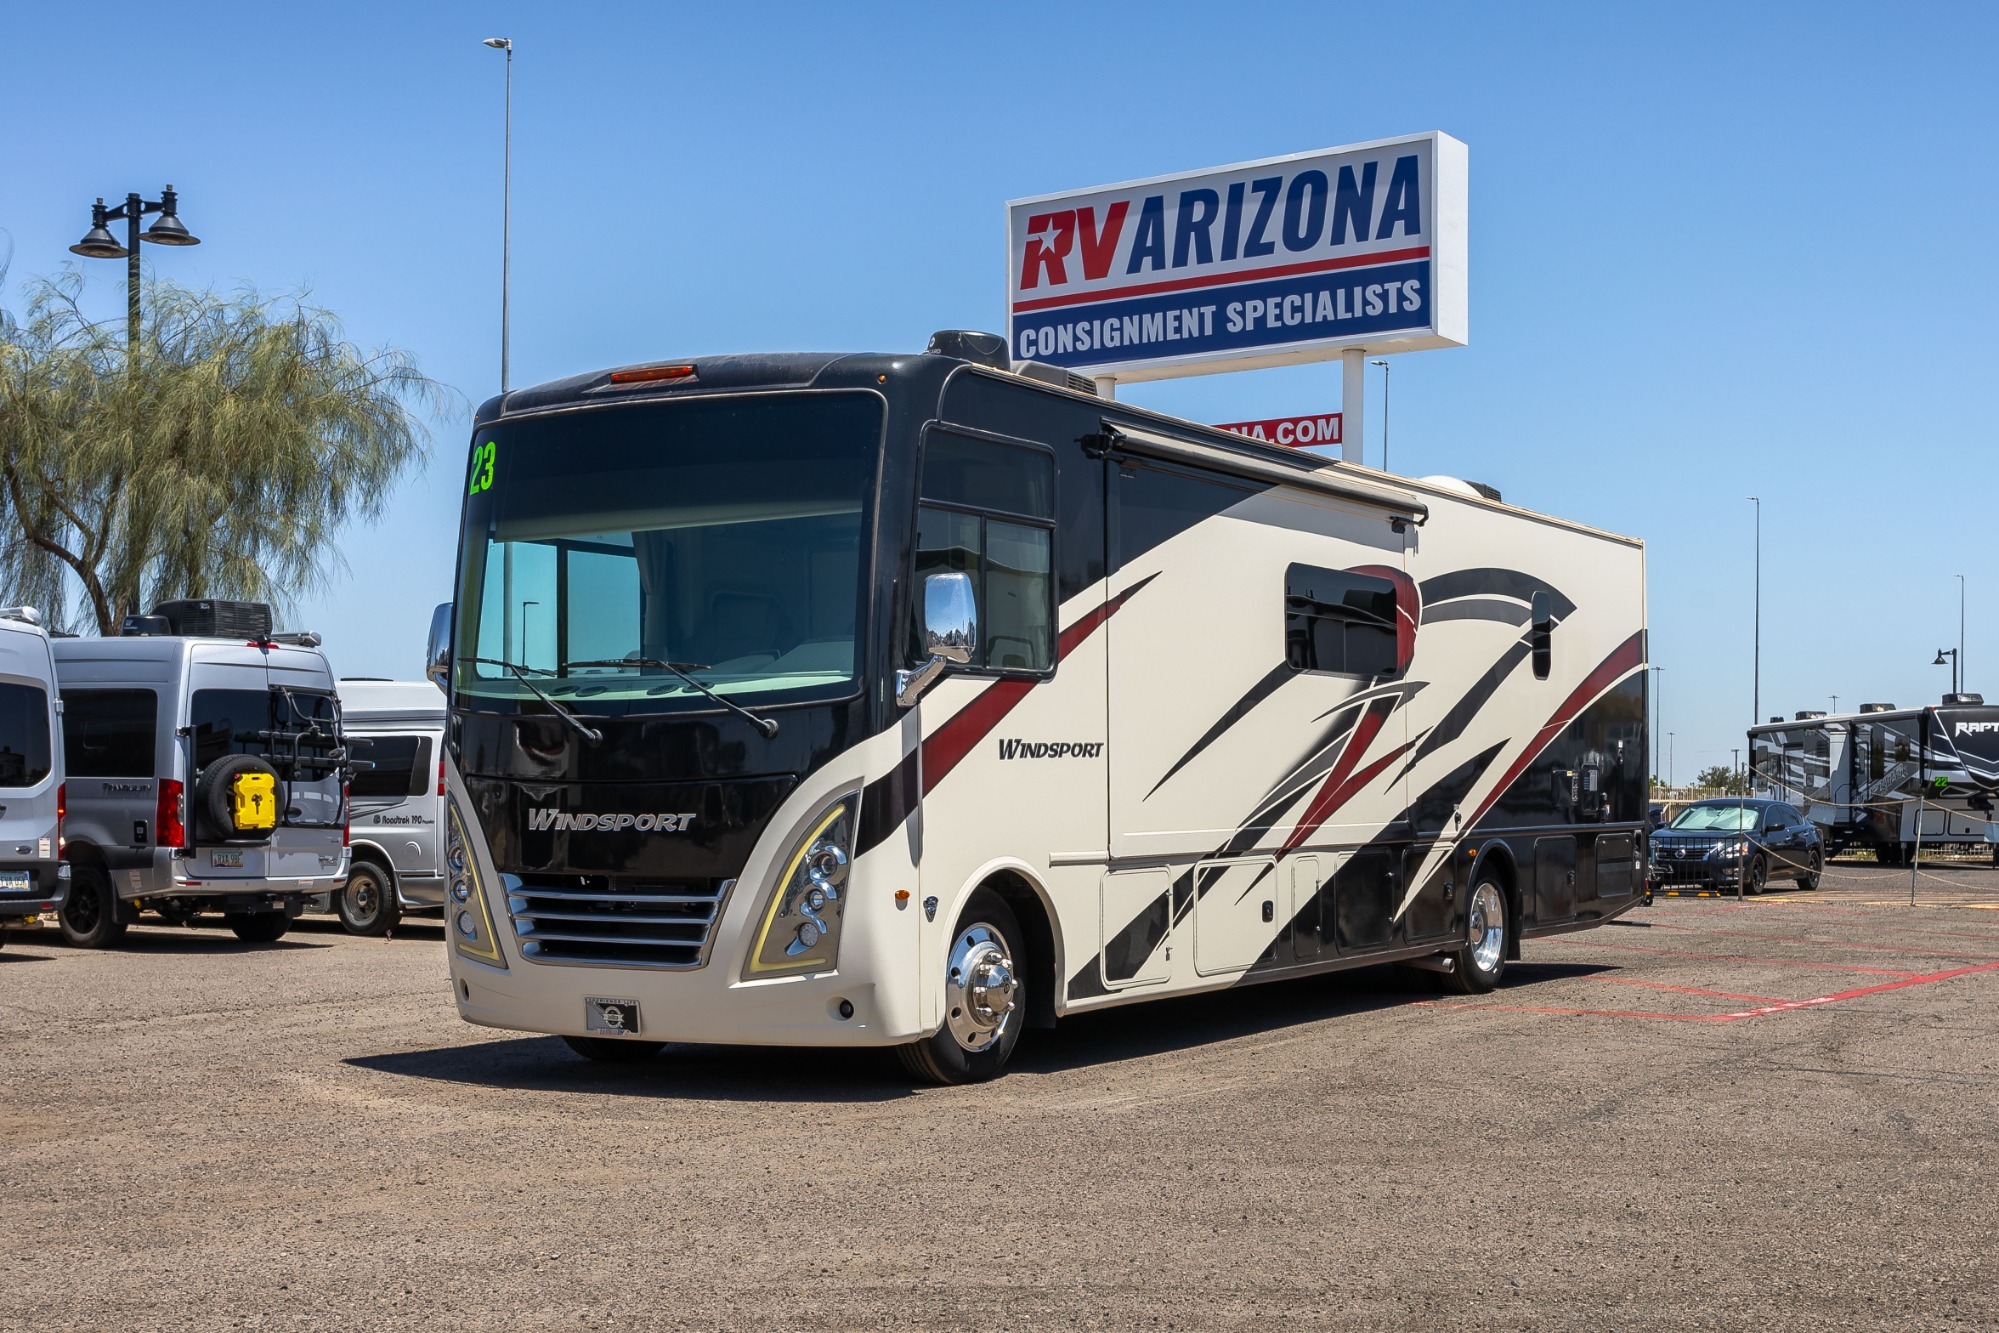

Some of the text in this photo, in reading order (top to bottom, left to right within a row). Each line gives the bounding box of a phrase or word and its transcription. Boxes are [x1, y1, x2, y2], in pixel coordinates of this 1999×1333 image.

[1126, 153, 1421, 275] ARIZONA
[1019, 278, 1422, 359] CONSIGNMENT SPECIALISTS
[469, 441, 497, 496] 23
[1934, 776, 1948, 787] 22
